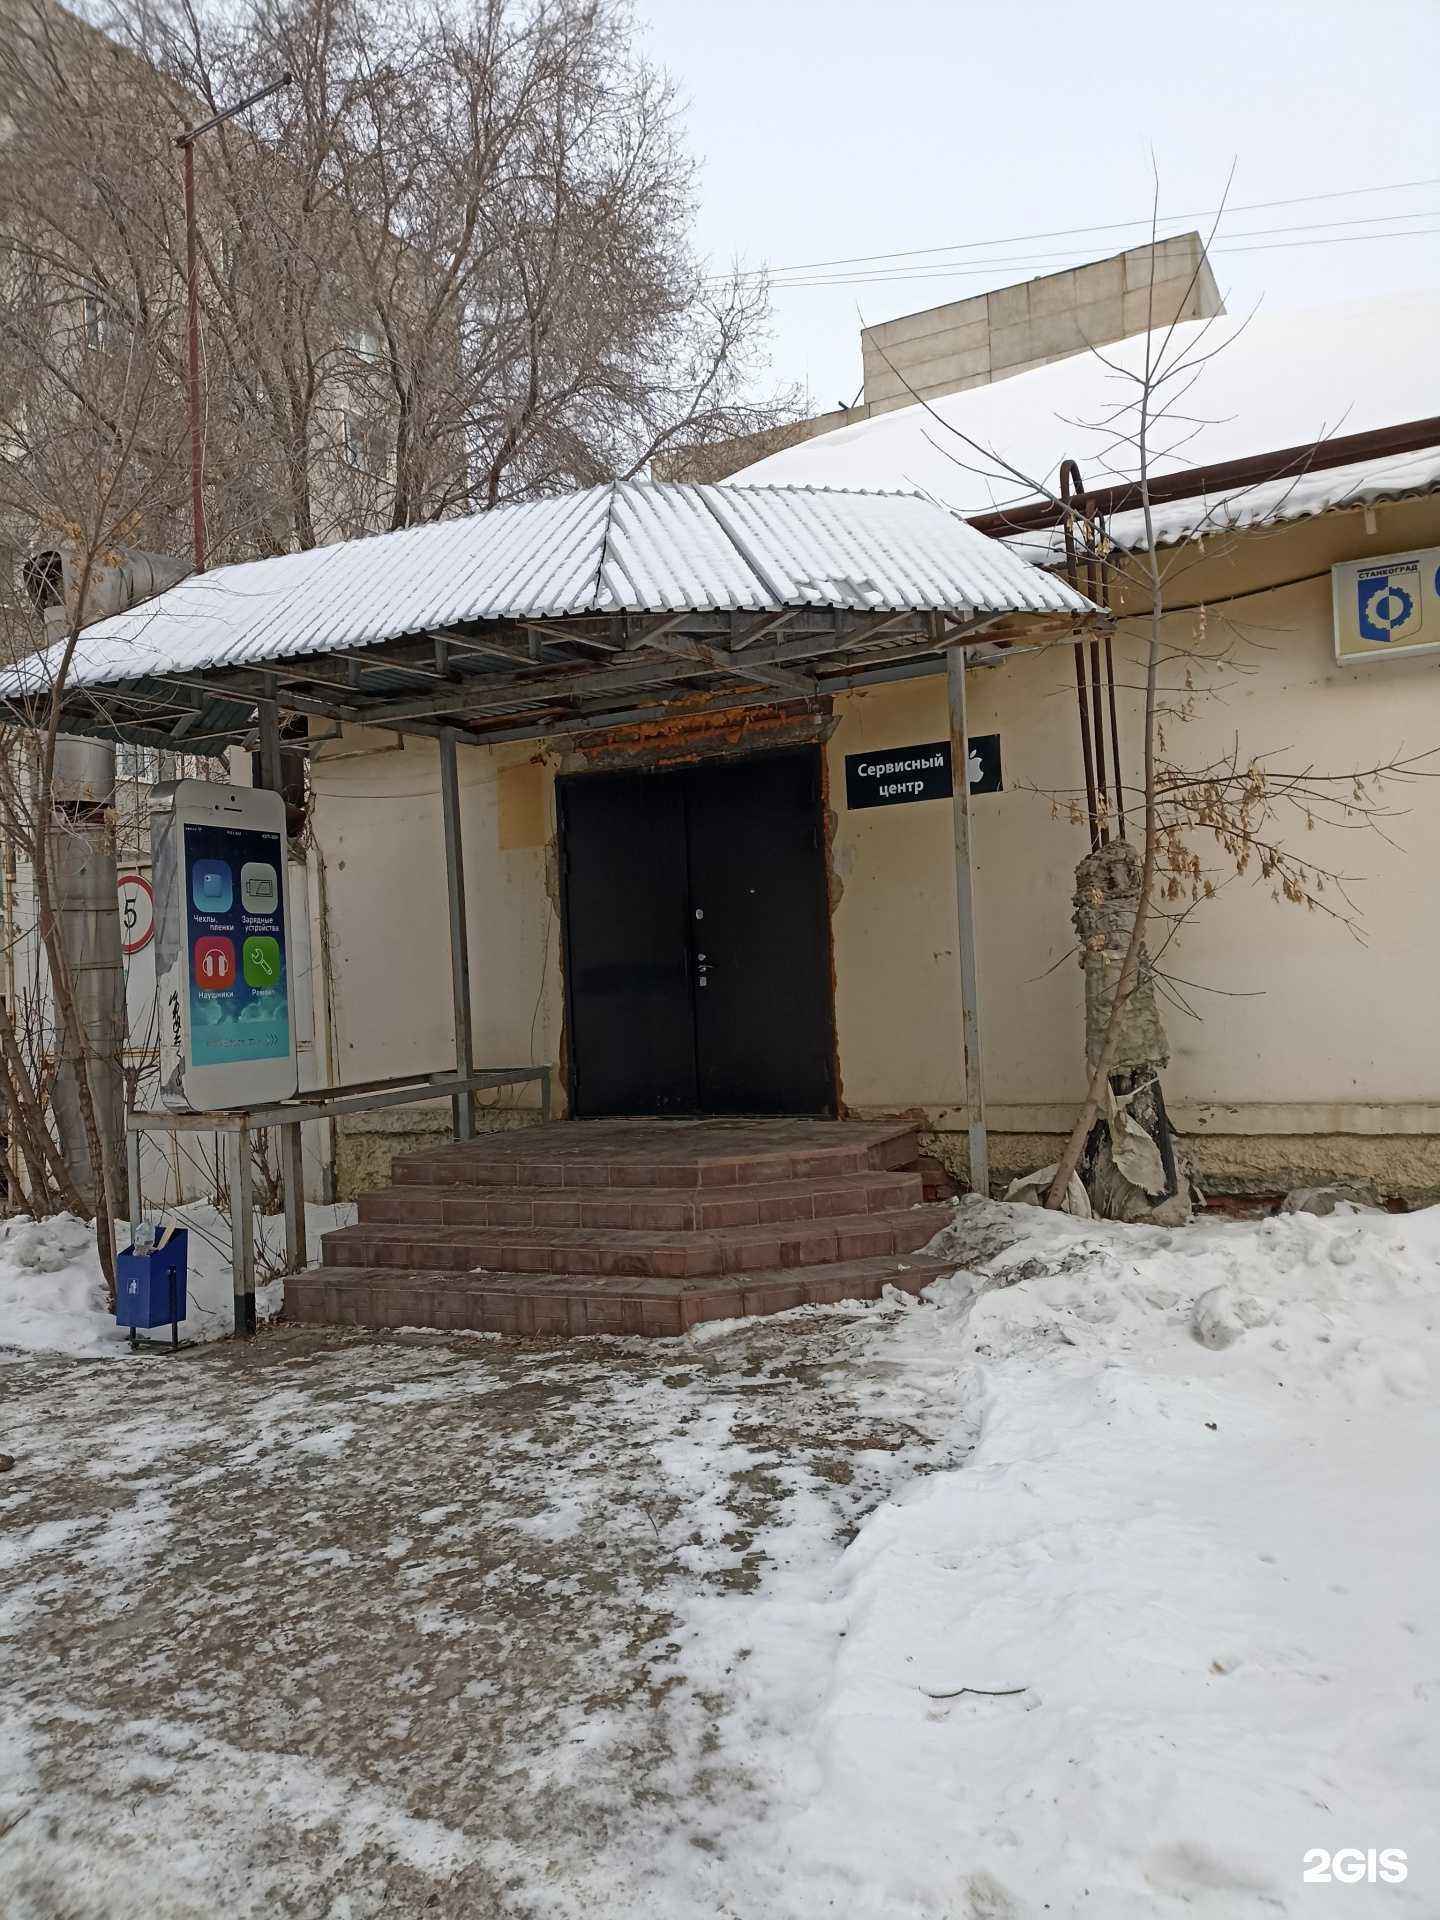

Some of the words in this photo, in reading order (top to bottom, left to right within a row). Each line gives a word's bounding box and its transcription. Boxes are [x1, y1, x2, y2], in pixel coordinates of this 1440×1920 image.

[1358, 564, 1418, 579] СТАНКОГРАД
[857, 752, 944, 778] Сервисный
[879, 780, 924, 798] центр
[124, 898, 137, 928] 5
[241, 916, 273, 924] Зарядные
[245, 924, 280, 932] устройства
[198, 991, 234, 999] Наушники
